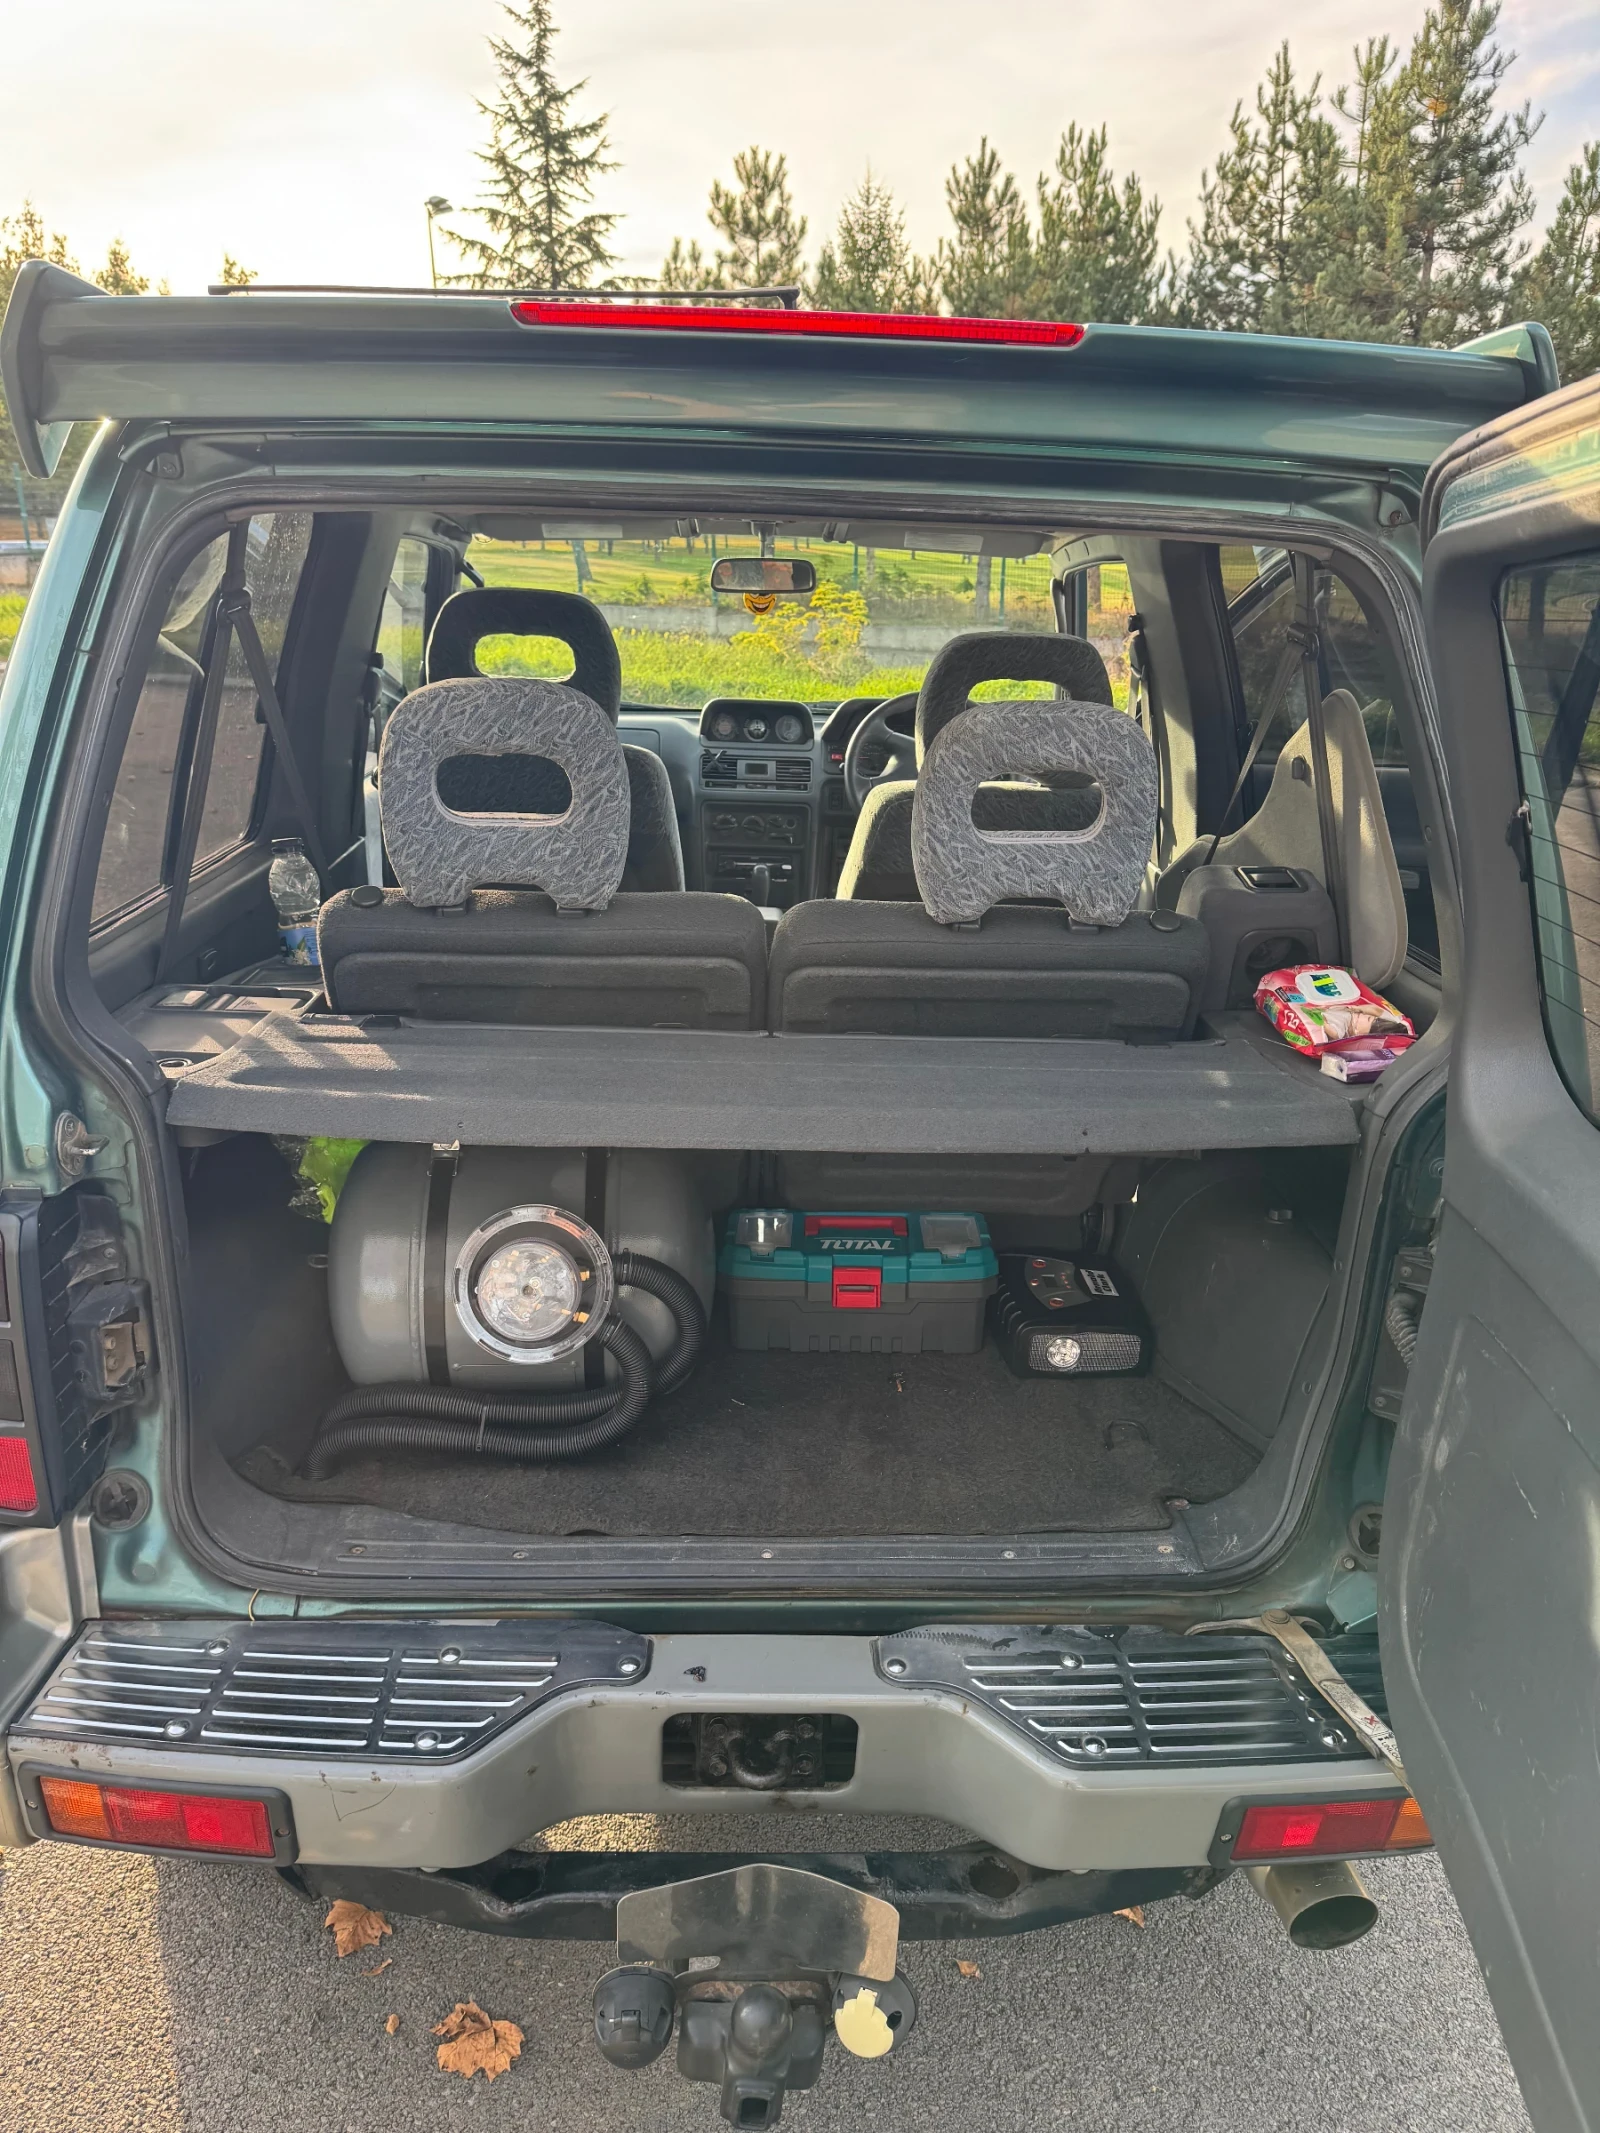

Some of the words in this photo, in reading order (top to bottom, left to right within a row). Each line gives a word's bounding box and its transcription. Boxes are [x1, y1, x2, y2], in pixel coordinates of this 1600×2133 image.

[820, 1239, 895, 1250] TOTAL
[1097, 1273, 1112, 1292] Clark
[1381, 1741, 1401, 1762] UNLOC
